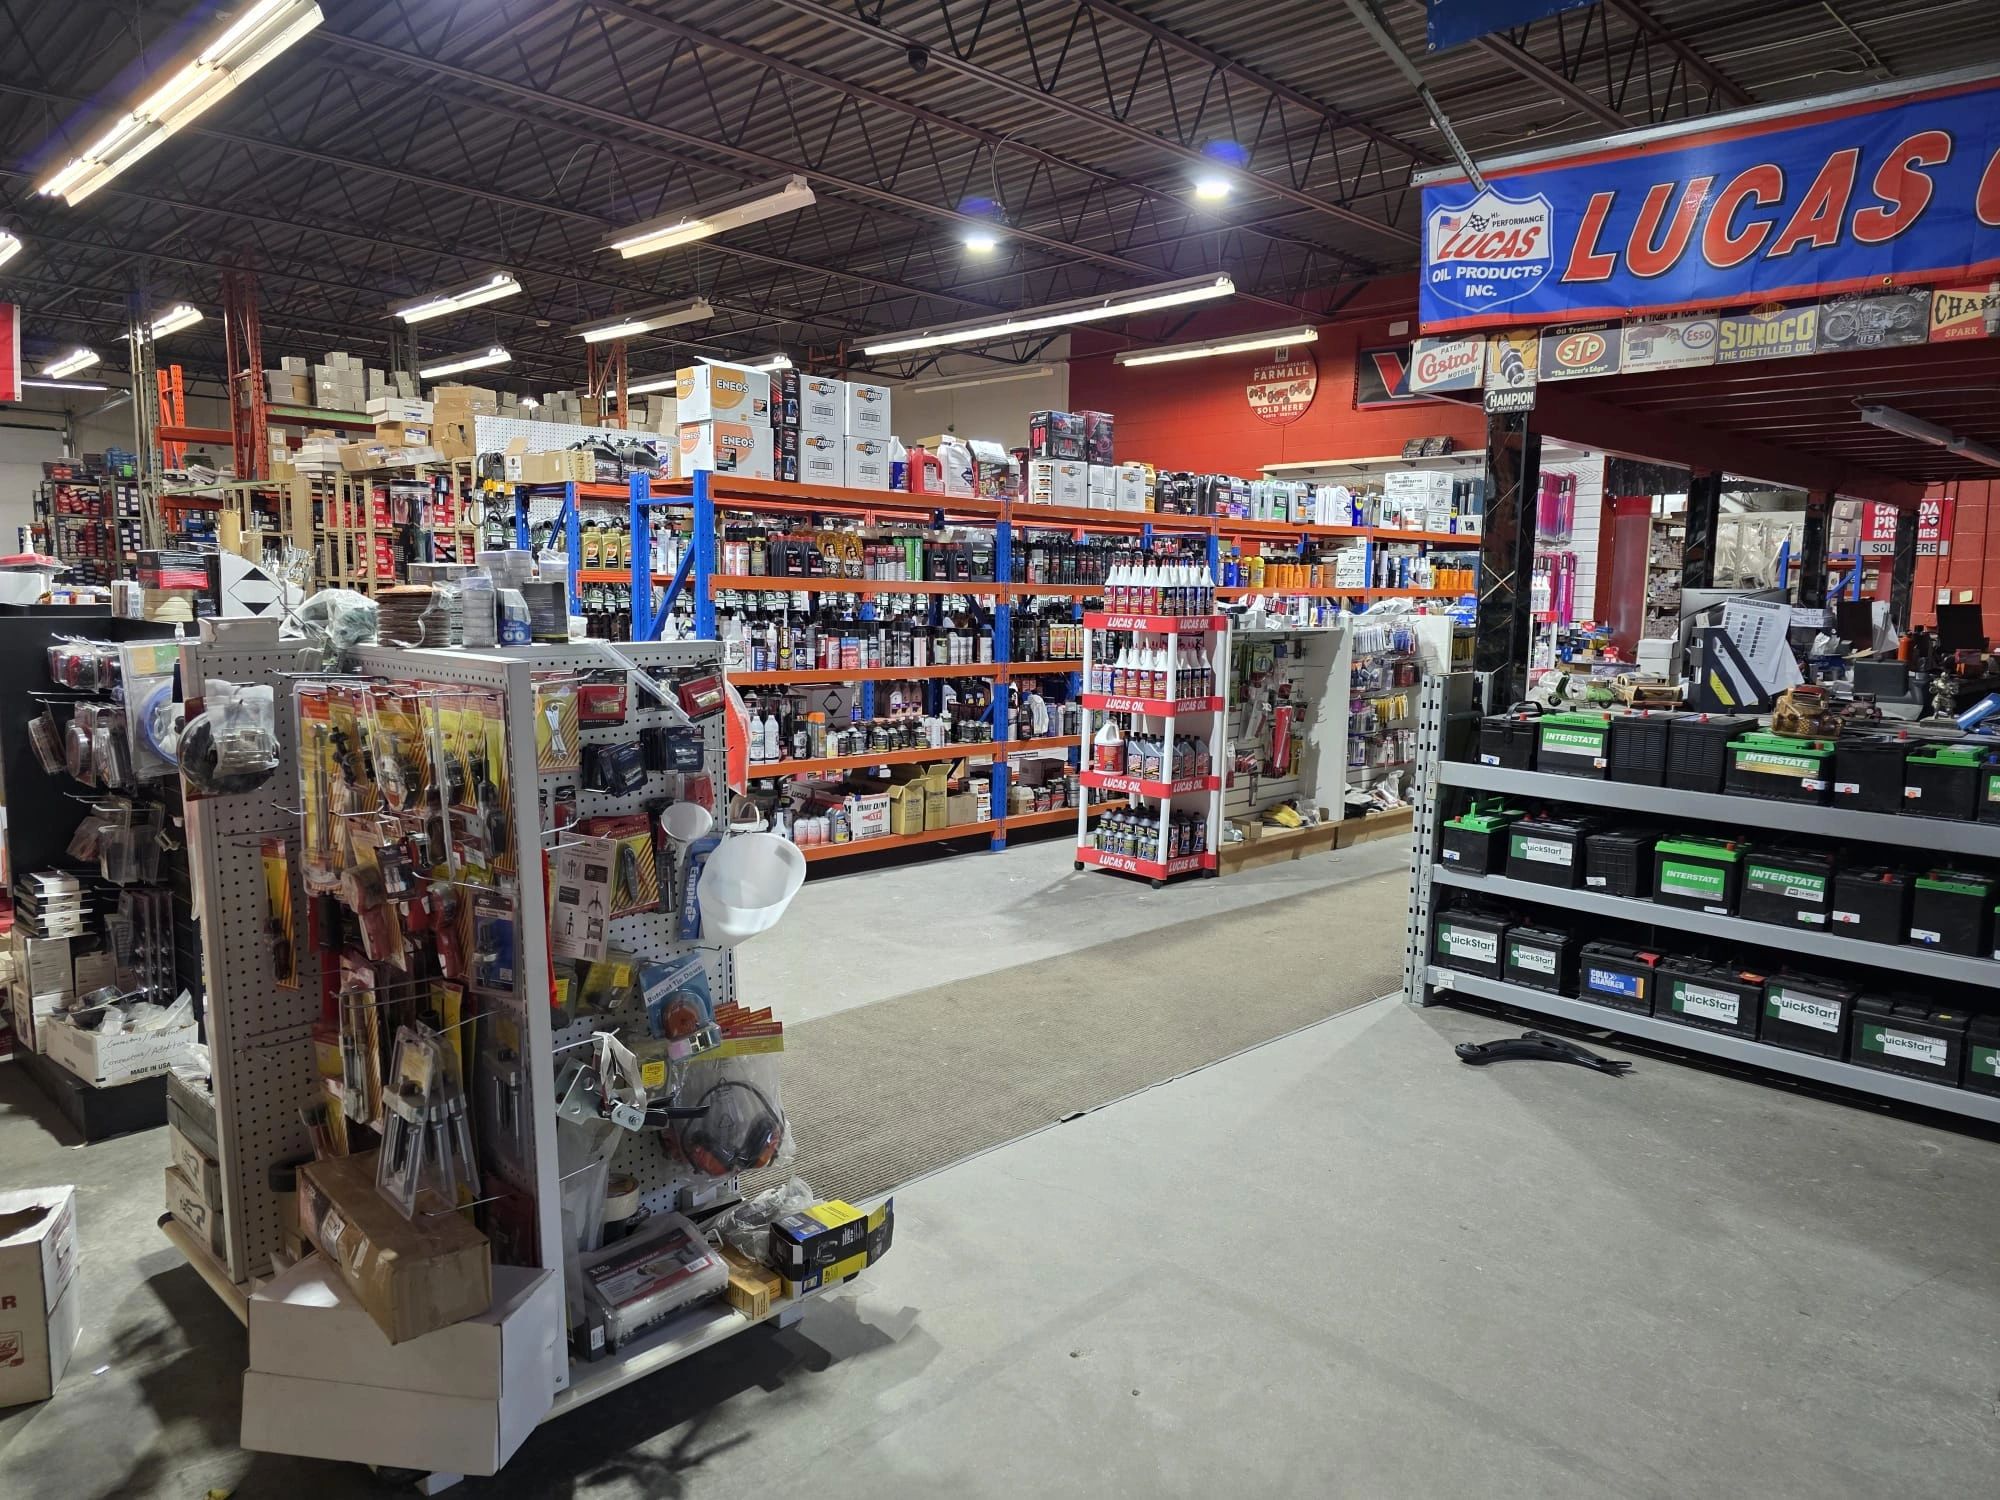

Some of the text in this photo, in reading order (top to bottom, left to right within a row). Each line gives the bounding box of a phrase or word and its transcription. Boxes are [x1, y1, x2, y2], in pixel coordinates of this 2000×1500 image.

[1559, 130, 1953, 284] LUCAS
[1492, 214, 1545, 228] PERFORMANCE
[1437, 226, 1542, 260] LUCAS
[1432, 265, 1543, 283] OIL PRODUCTS
[1465, 284, 1497, 298] INC.
[1908, 287, 1930, 302] DIE
[1555, 323, 1608, 335] Oil Treatment
[1719, 310, 1816, 351] SUNOCO
[1945, 326, 1979, 338] SPARK
[1860, 334, 1881, 344] USA
[1440, 342, 1466, 355] PATENT
[1562, 334, 1600, 362] STP
[1719, 350, 1737, 361] THE
[1739, 345, 1792, 359] DISTILLED
[1418, 343, 1478, 384] Castrol
[1254, 366, 1309, 381] FARMALL
[1447, 365, 1482, 379] MOTOR OIL
[716, 379, 750, 394] ENEOS
[1257, 403, 1304, 415] SOLD HERE
[1485, 390, 1534, 413] CHAMPION
[721, 435, 755, 448] ENEOS
[1107, 617, 1148, 629] LUCAS OIL
[1180, 618, 1209, 629] LUCAS OIL
[1106, 699, 1145, 712] LUCAS OIL
[1177, 701, 1207, 712] LUCAS OIL
[1545, 732, 1600, 745] INTERSTATE
[1745, 752, 1811, 768] INTERSTATE
[1103, 776, 1142, 792] LUCAS OIL
[1173, 780, 1204, 793] LUCAS OIL
[1520, 842, 1563, 856] QuickStart
[1099, 855, 1137, 872] LUCAS OIL
[1168, 858, 1199, 872] LUCAS OIL
[1666, 869, 1720, 884] INTERSTATE
[1751, 868, 1823, 889] INTERSTATE
[685, 866, 699, 915] Empire
[1441, 931, 1496, 953] QuickStart
[1511, 949, 1554, 966] QuickStart
[647, 965, 704, 1003] Ratchet Tie Down
[1590, 976, 1625, 990] CRANKER
[1674, 990, 1738, 1012] QuickStart
[1770, 995, 1838, 1020] QuickStart
[1875, 1033, 1933, 1053] QuickStart
[130, 1067, 148, 1076] MADE
[158, 1061, 171, 1071] USA
